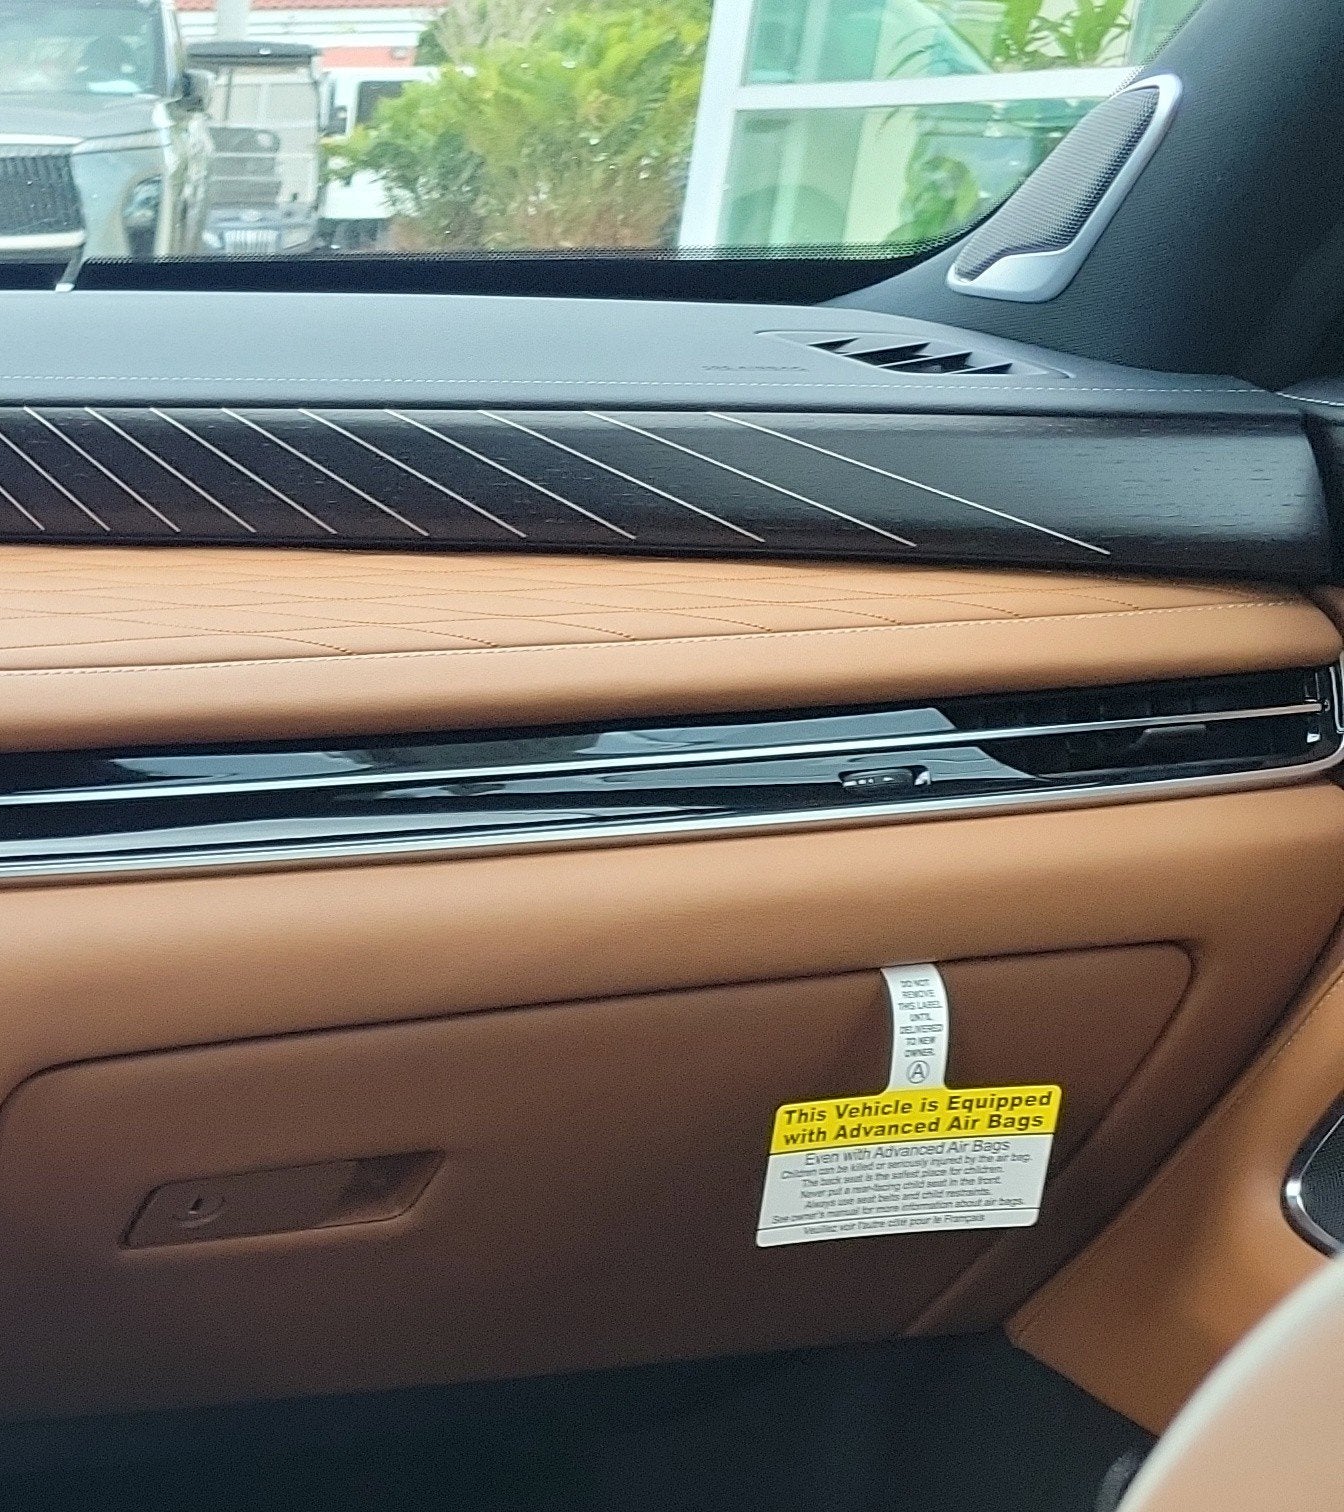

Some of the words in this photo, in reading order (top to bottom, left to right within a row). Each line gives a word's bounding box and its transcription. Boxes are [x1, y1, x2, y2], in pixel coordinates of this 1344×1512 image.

[783, 1107, 827, 1126] This
[836, 1098, 912, 1120] Vehicle
[919, 1096, 939, 1113] is
[947, 1091, 1052, 1113] Equipped
[783, 1126, 827, 1146] with
[834, 1116, 940, 1141] Advanced
[948, 1114, 979, 1131] Air
[987, 1113, 1044, 1132] Bags
[805, 1153, 839, 1166] Even
[844, 1148, 871, 1161] with
[874, 1141, 944, 1158] Advanced
[947, 1140, 968, 1154] Air
[971, 1139, 1011, 1155] Bags
